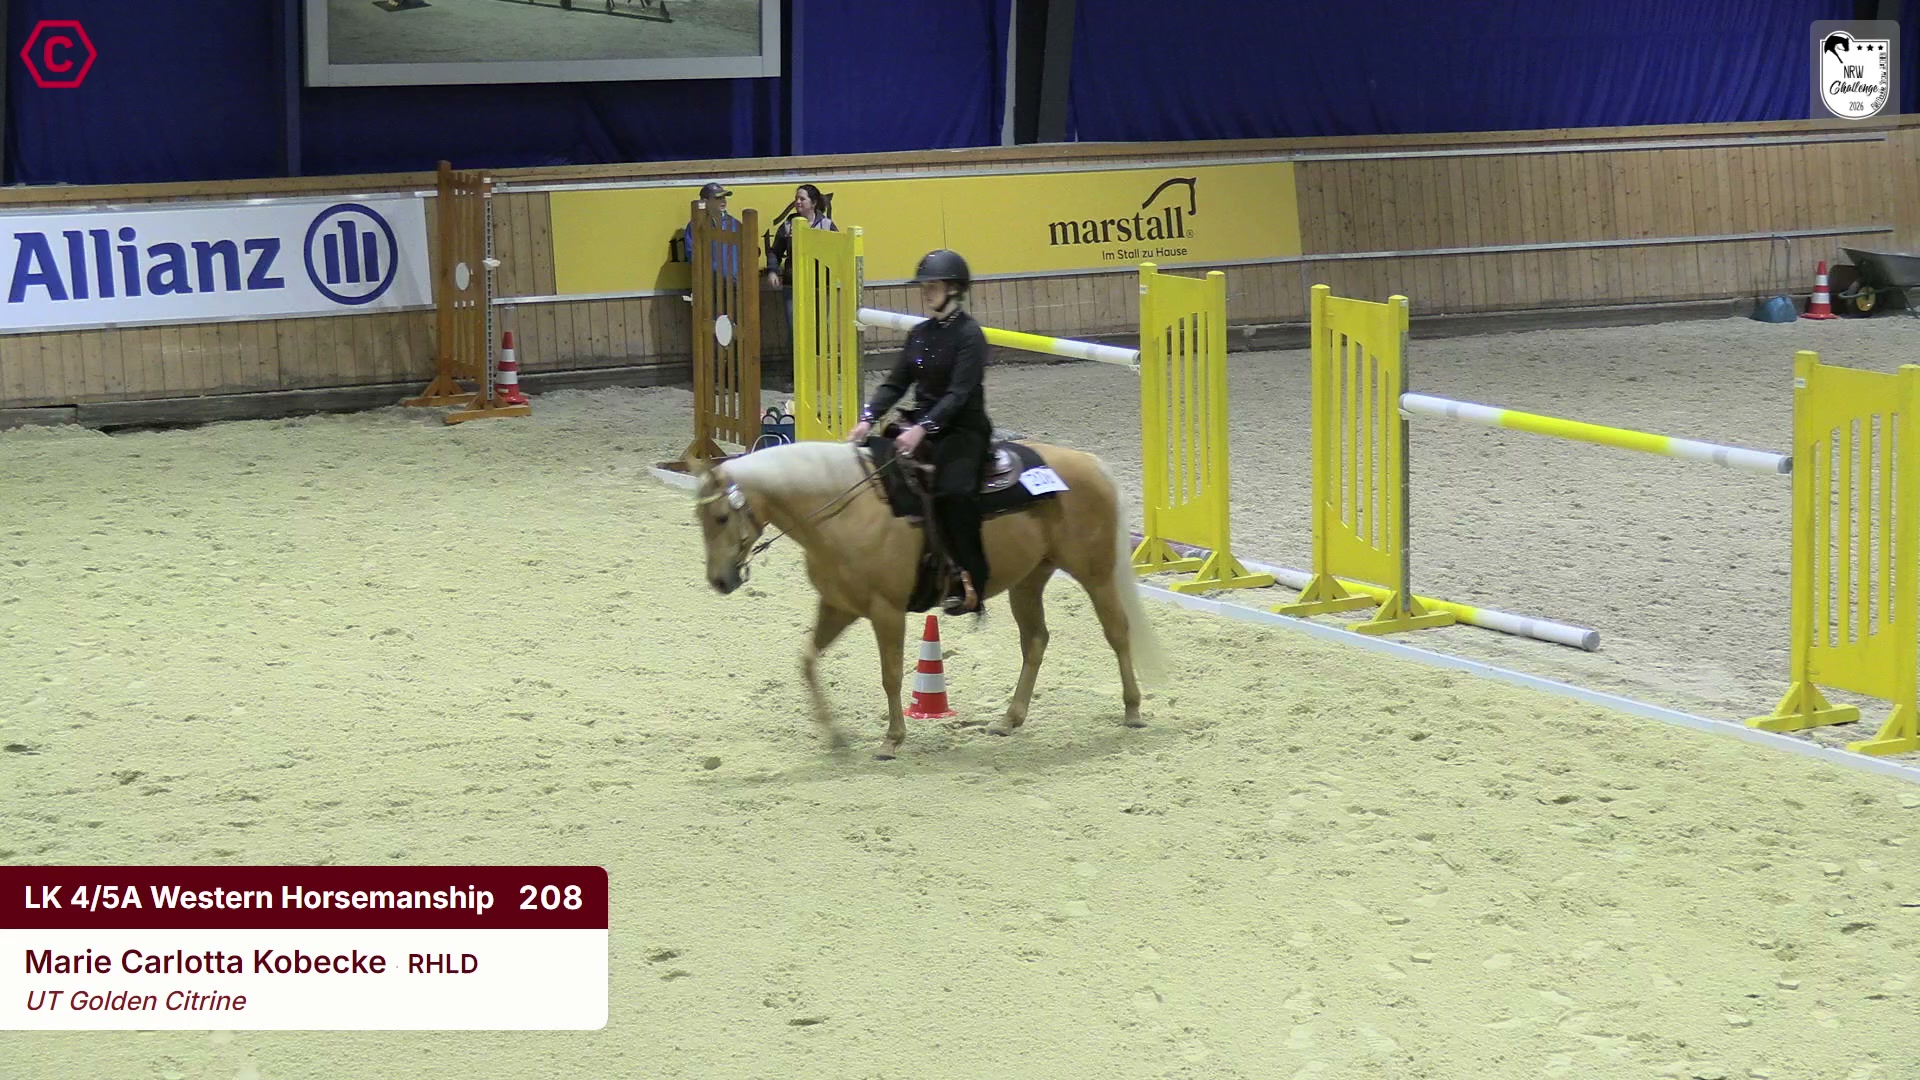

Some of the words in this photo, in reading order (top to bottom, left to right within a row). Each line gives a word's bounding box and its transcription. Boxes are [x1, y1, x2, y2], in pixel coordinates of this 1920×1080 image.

[1049, 206, 1185, 246] marstall
[8, 226, 286, 304] Allianz
[1102, 251, 1115, 261] Im
[1117, 249, 1139, 260] Stall
[1156, 247, 1188, 257] Hause
